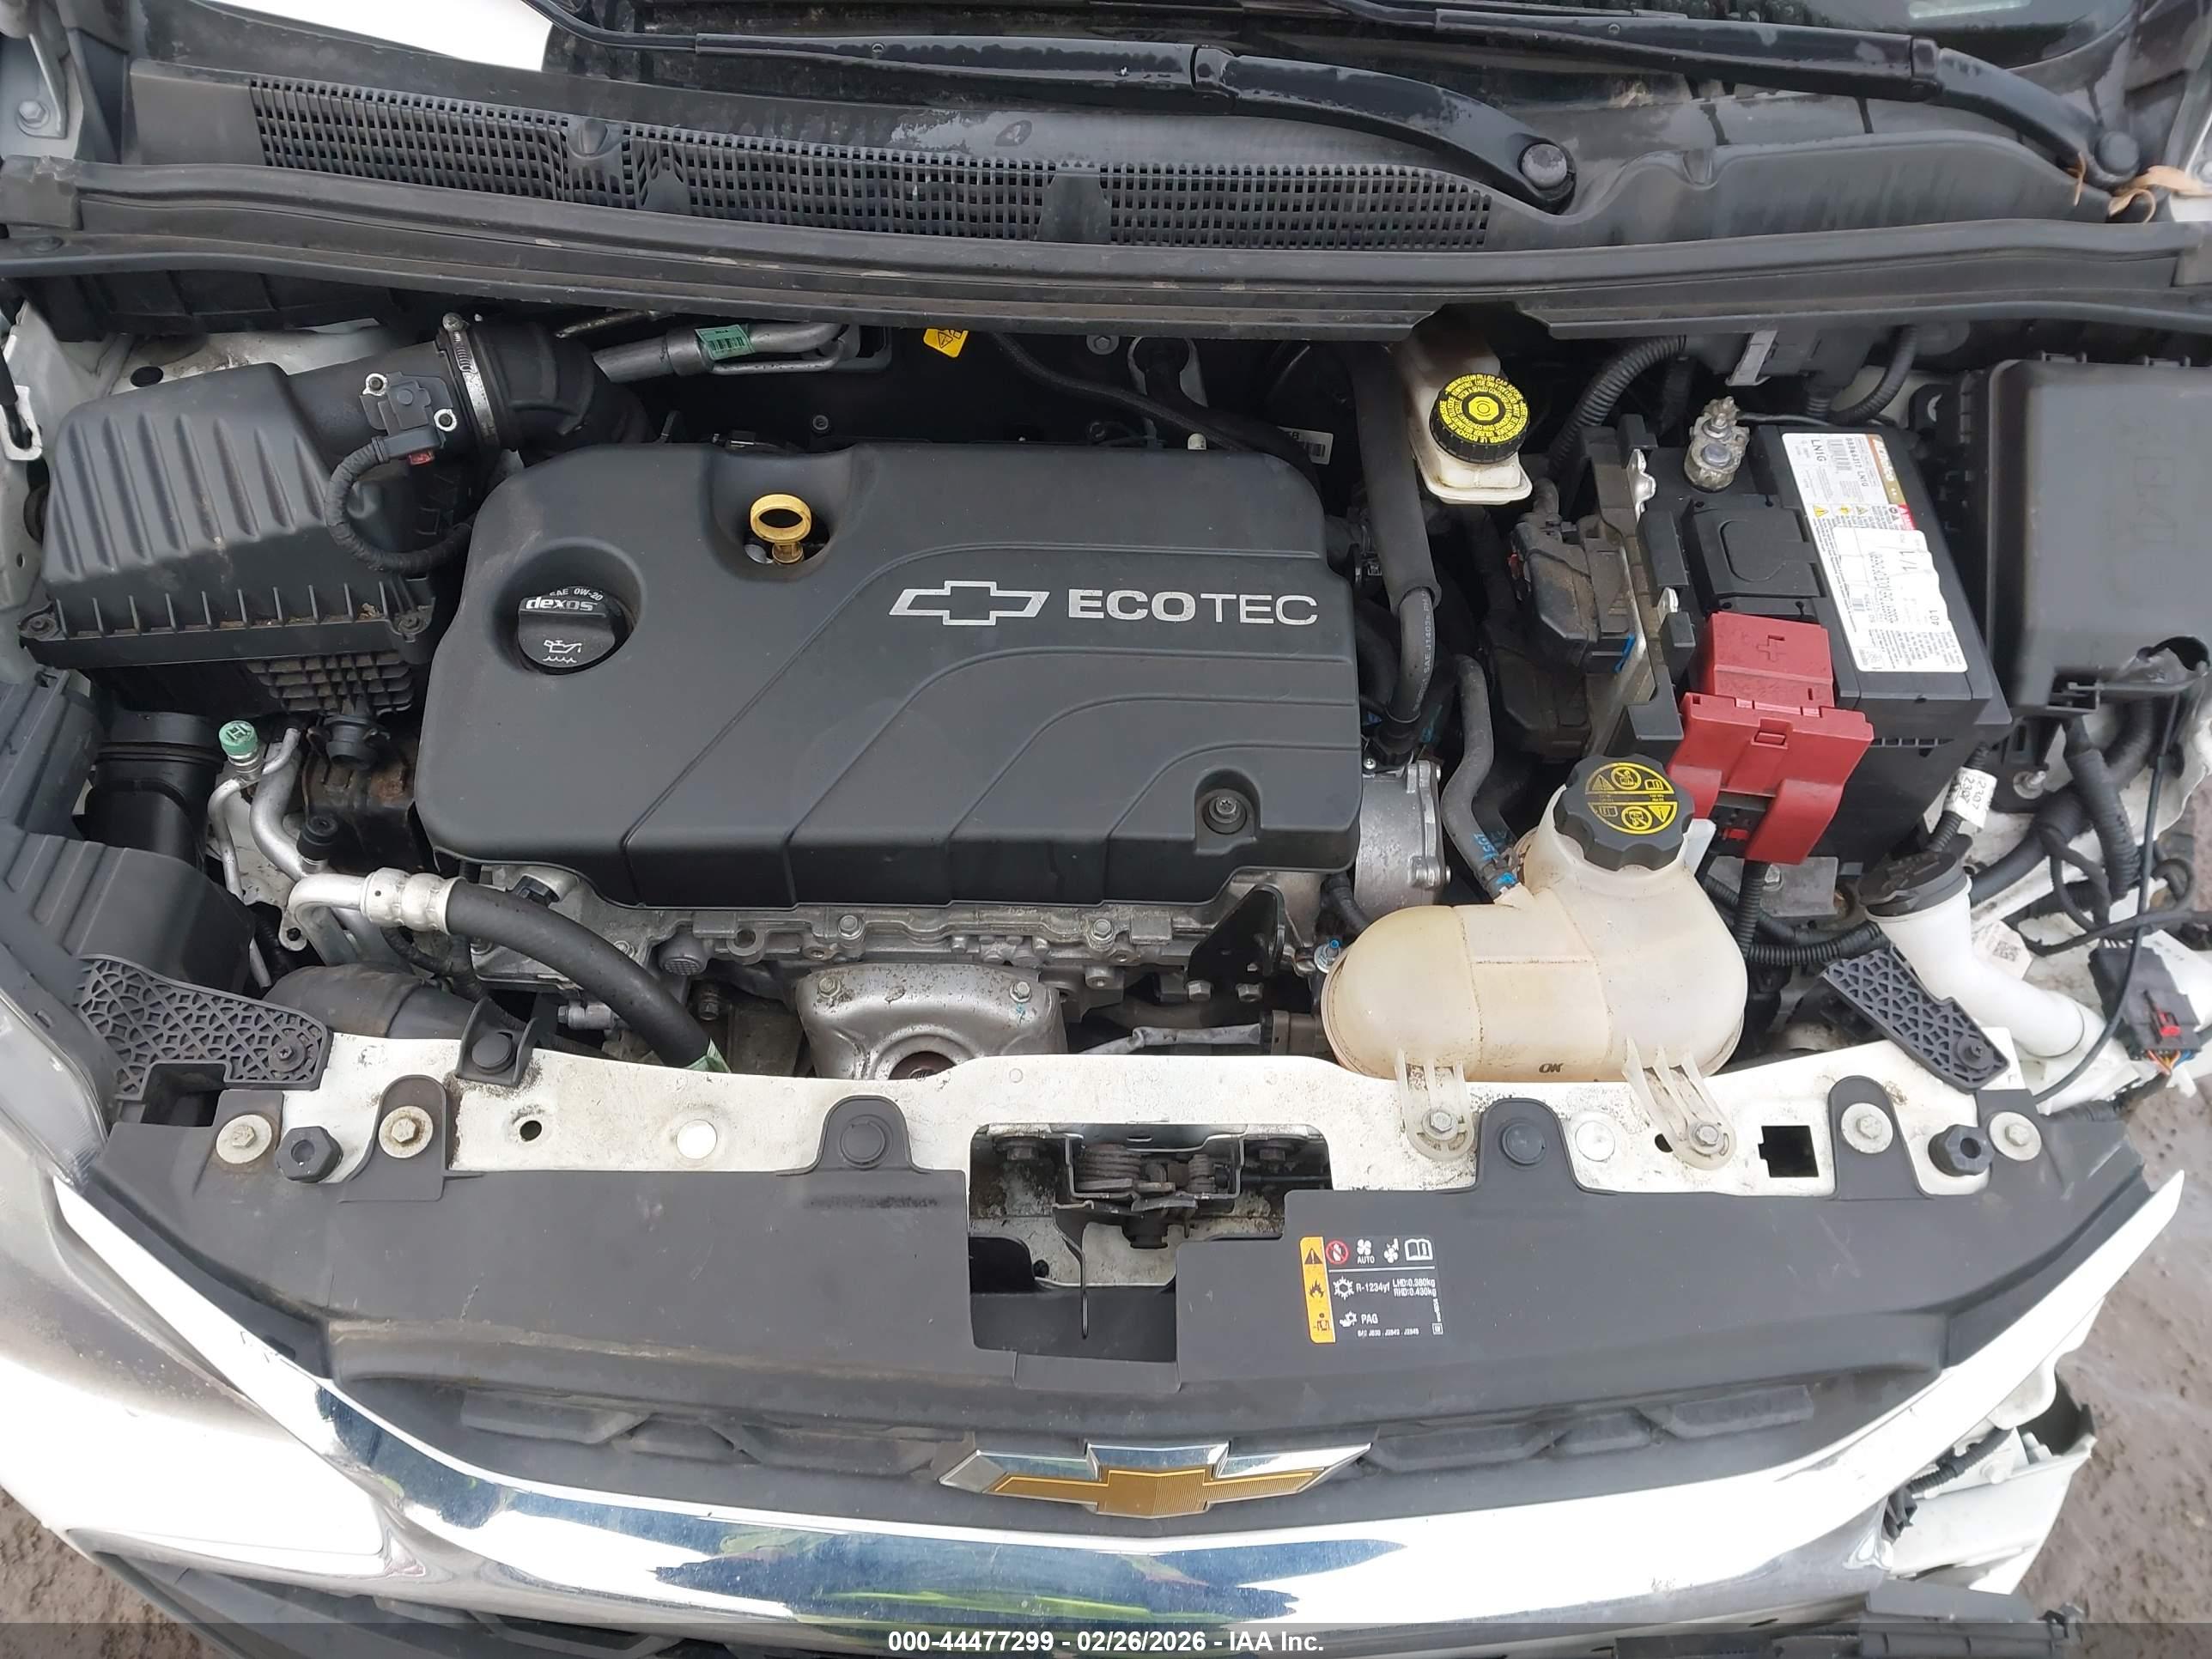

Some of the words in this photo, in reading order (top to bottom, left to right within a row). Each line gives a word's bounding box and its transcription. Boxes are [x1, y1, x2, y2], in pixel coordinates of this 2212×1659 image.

[1494, 377, 1509, 386] CAP
[1811, 440, 1826, 462] LN1G
[574, 588, 604, 601] 0W-20
[526, 597, 599, 611] dexos
[1068, 588, 1319, 626] ECOTEC
[226, 726, 247, 740] H
[1357, 1255, 1376, 1265] AUTO
[1355, 1282, 1391, 1294] R-1234yf
[1360, 1313, 1379, 1325] PAG
